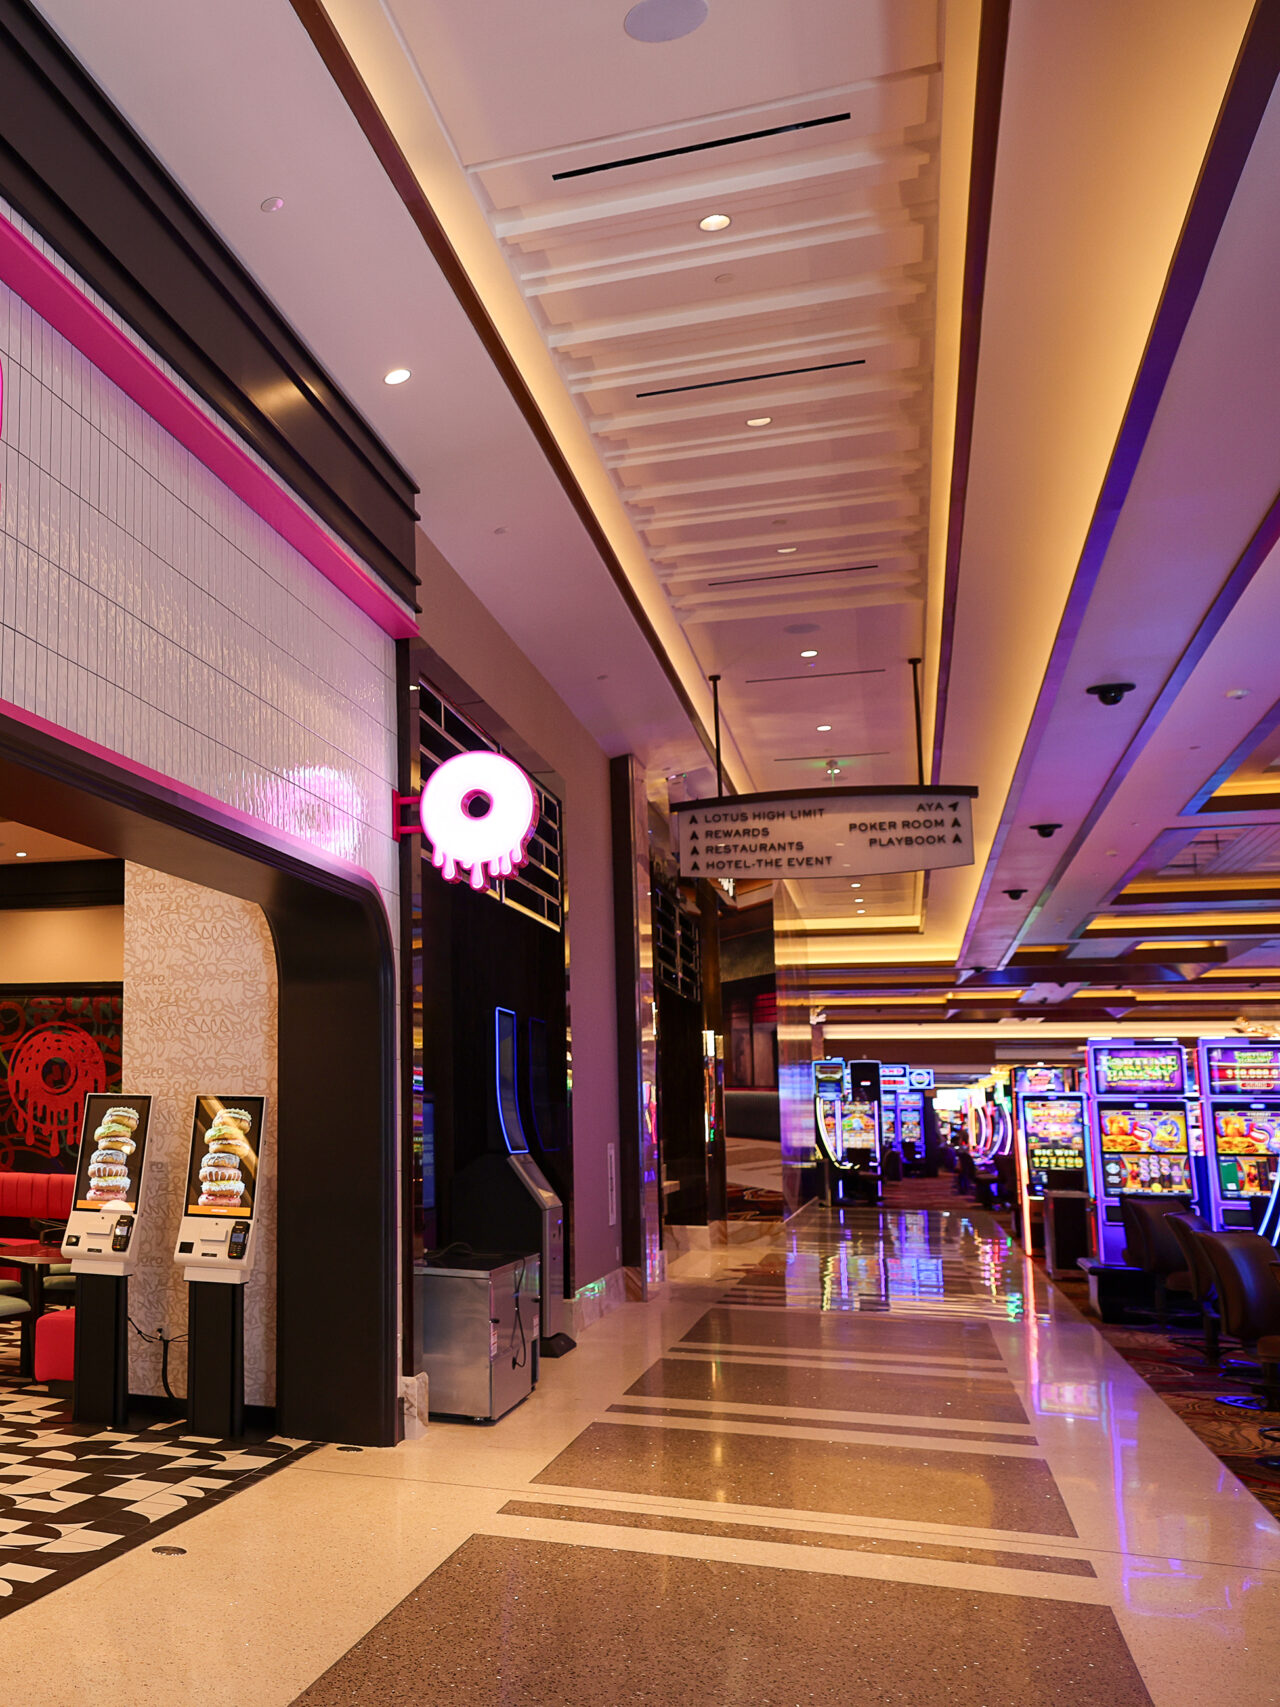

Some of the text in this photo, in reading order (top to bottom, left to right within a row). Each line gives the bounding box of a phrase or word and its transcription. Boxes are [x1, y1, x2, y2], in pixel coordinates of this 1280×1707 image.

[916, 802, 944, 812] AYA
[704, 808, 825, 823] LOTUS HIGH LIMIT
[848, 819, 945, 832] POKER ROOM
[704, 827, 770, 839] REWARDS
[869, 835, 946, 847] PLAYBOOK
[705, 841, 804, 854] RESTAURANTS
[787, 856, 833, 867] EVENT
[1033, 1148, 1054, 1157] BIG
